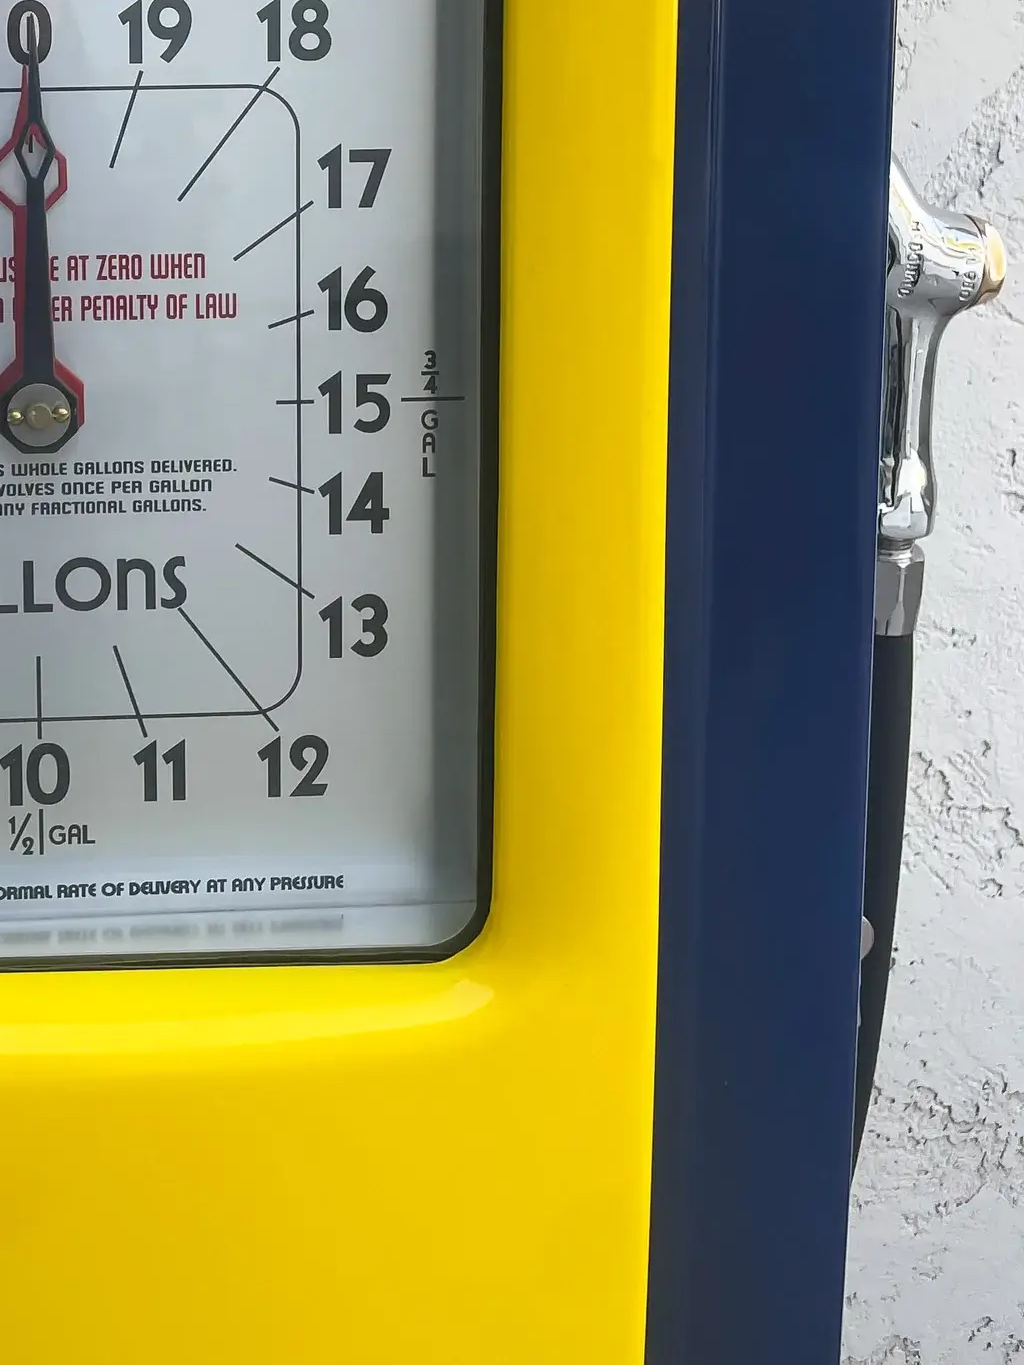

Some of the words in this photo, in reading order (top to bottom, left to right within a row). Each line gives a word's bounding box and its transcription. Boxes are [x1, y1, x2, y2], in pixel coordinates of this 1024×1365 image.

[6, 0, 53, 65] 0
[317, 143, 393, 209] 17
[66, 255, 90, 282] AT
[95, 253, 143, 281] ZERO
[150, 252, 206, 280] WHEN
[80, 294, 159, 322] PENALTY
[165, 293, 188, 320] OF
[195, 292, 237, 320] LAW
[317, 265, 389, 333] 16
[317, 370, 392, 435] 15
[11, 462, 68, 477] WHOLE
[73, 460, 145, 476] GALLONS
[150, 458, 238, 474] DELIVERED.
[61, 481, 105, 496] ONCE
[111, 480, 143, 494] PER
[149, 478, 212, 494] GALLON
[31, 500, 127, 516] FRACTIONAL
[132, 498, 207, 513] GALLONS.
[317, 471, 390, 536] 14
[318, 593, 389, 659] 13
[132, 738, 187, 802] 11
[257, 734, 329, 798] 12
[48, 823, 96, 846] GAL
[56, 882, 97, 899] RATE
[100, 882, 125, 897] OF
[128, 879, 202, 897] DELIVERY
[206, 878, 228, 893] AT
[231, 877, 267, 893] ANY
[270, 874, 344, 891] PRESSURE
